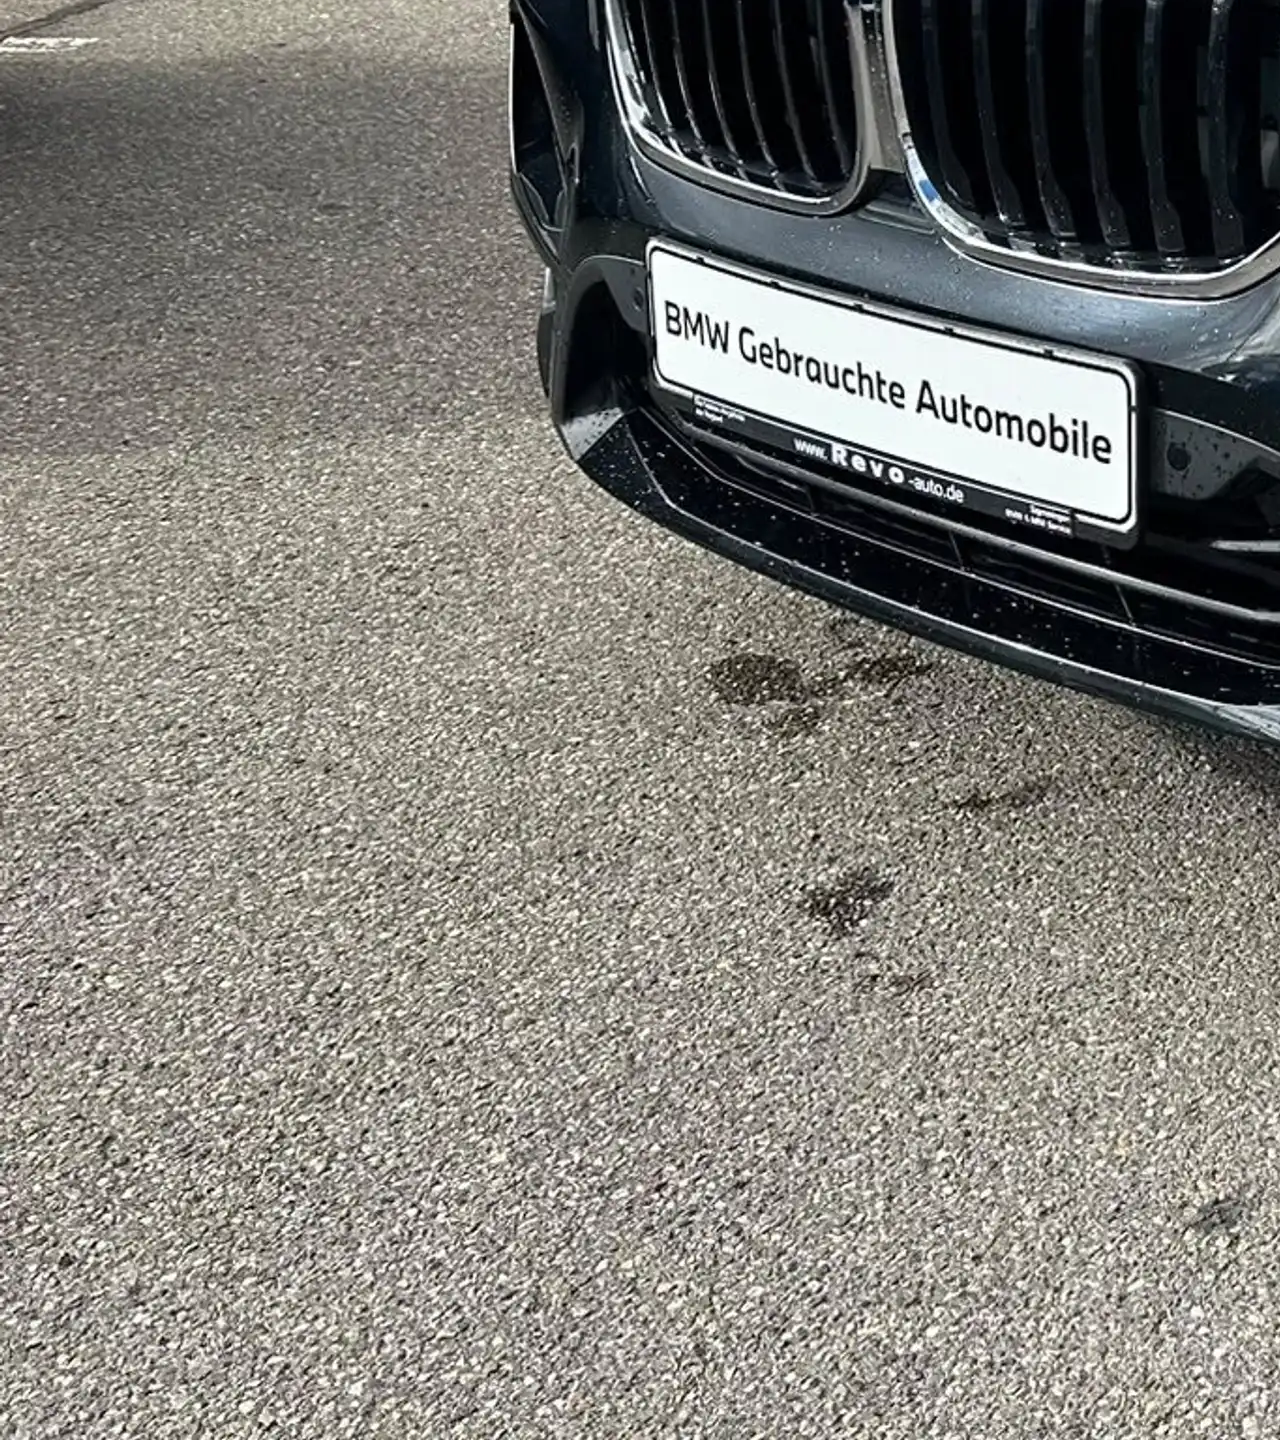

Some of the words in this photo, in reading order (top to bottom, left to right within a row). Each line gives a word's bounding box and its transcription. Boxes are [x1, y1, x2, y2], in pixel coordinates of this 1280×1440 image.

[664, 300, 730, 355] BMW
[738, 327, 906, 409] Gebrauchte
[915, 379, 1112, 465] Automobile
